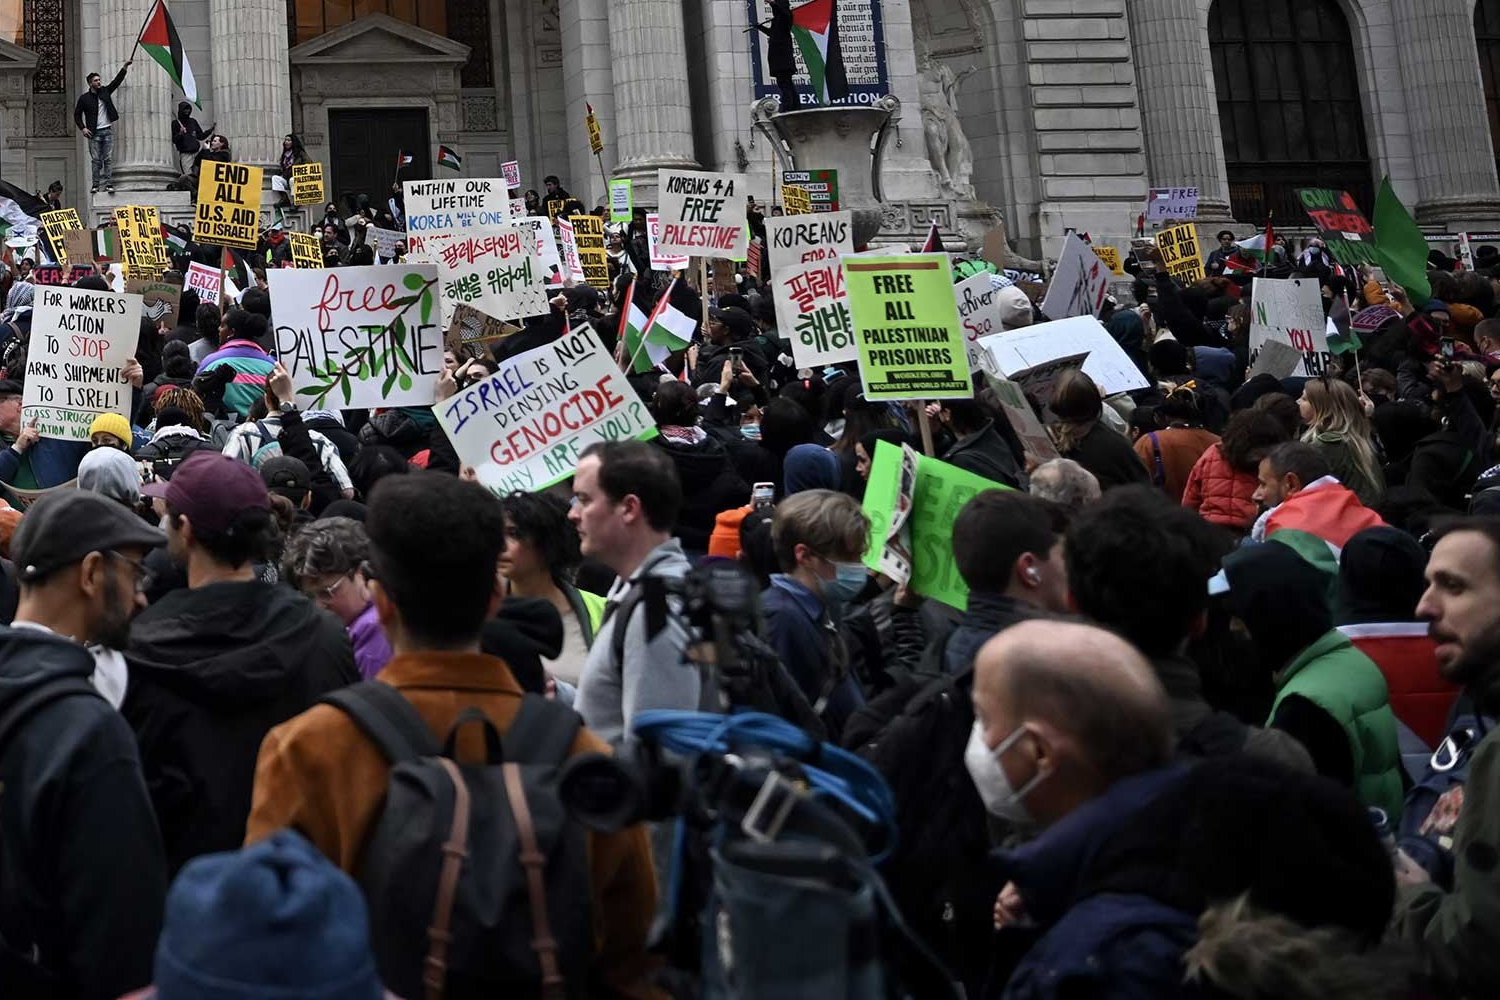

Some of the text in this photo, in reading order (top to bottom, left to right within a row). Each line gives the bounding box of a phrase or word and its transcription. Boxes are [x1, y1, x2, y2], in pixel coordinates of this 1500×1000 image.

[215, 163, 249, 185] END
[215, 184, 244, 205] ALL
[411, 181, 491, 197] WITHIN OUR
[667, 176, 735, 197] KOREANS 4 A
[1172, 188, 1198, 200] FREE
[431, 195, 485, 210] LIFETIME
[680, 199, 725, 223] FREE
[1159, 205, 1197, 214] PALESTI
[43, 212, 77, 226] PALESTINE
[200, 204, 255, 226] U.S. AID
[409, 211, 502, 231] KOREA WILL ONE
[197, 222, 254, 242] TO ISRAEL!
[662, 226, 741, 250] PALESTINE
[773, 221, 847, 249] KOREANS
[1158, 227, 1193, 248] END ALL
[440, 231, 521, 269] 팔레스타인의
[189, 272, 219, 291] GAZA
[445, 272, 482, 302] 해방을
[873, 274, 914, 294] FREE
[44, 290, 126, 315] FOR WORKERS
[311, 273, 406, 331] free
[885, 301, 915, 321] ALL
[58, 314, 105, 336] ACTION
[964, 318, 992, 342] Sea
[863, 328, 949, 345] PALESTINIAN
[1286, 327, 1314, 352] YOU
[45, 336, 110, 362] TO STOP
[276, 325, 441, 380] PALESTINE
[869, 348, 953, 367] PRISONERS
[28, 361, 129, 385] ARMS SHIPMENTS
[1304, 350, 1330, 376] HELP
[446, 325, 597, 434] ISRAEL IS NOT
[38, 385, 119, 410] TO ISREL!
[493, 371, 579, 429] DENYING
[490, 375, 625, 466] GENOCIDE
